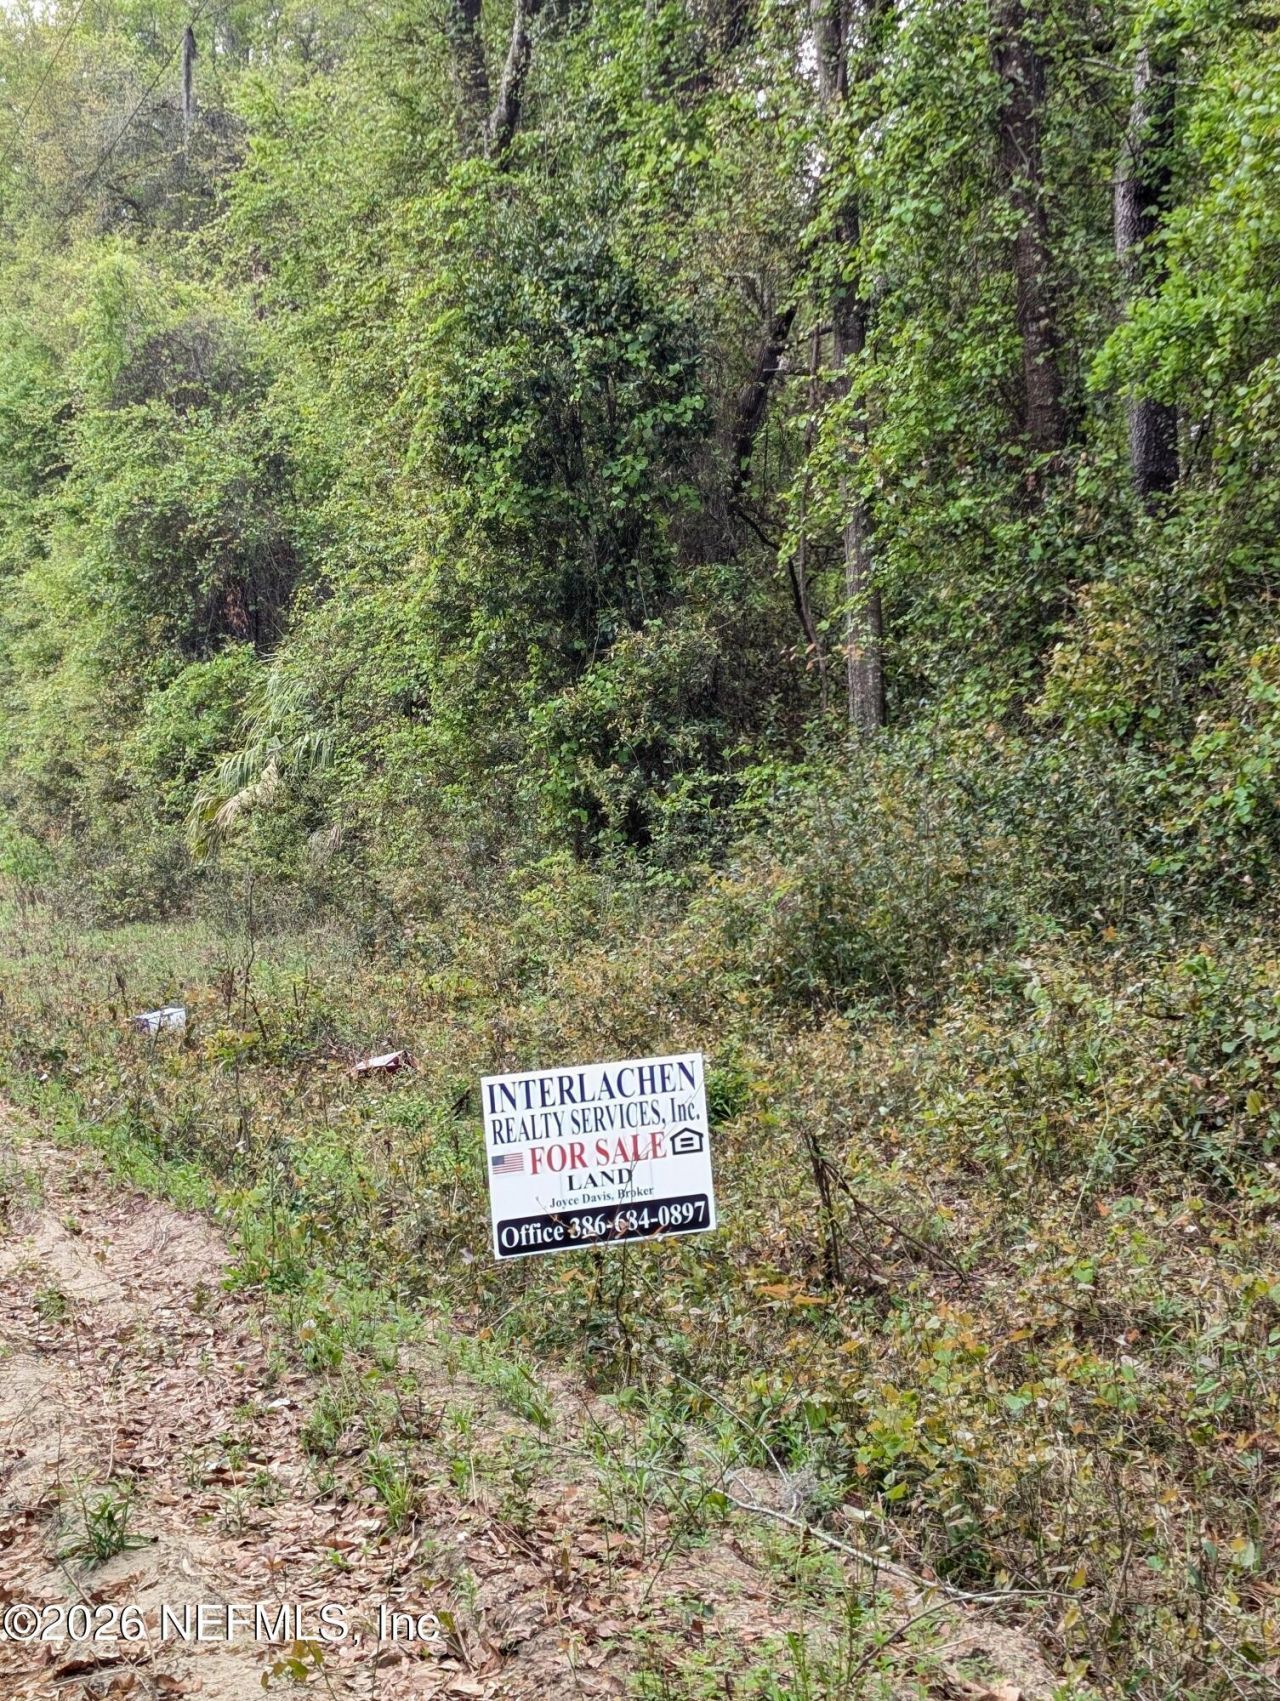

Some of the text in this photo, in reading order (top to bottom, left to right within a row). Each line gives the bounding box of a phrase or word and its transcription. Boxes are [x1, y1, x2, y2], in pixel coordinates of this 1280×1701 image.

[488, 1060, 696, 1114] INTERLACHEN
[491, 1097, 700, 1145] REALTY SERVICES, Inc.
[529, 1131, 668, 1175] FOR SALE
[549, 1186, 655, 1209] Joyce Davis, Broker
[568, 1168, 633, 1191] LAND
[501, 1201, 707, 1249] Office 386-684-0897
